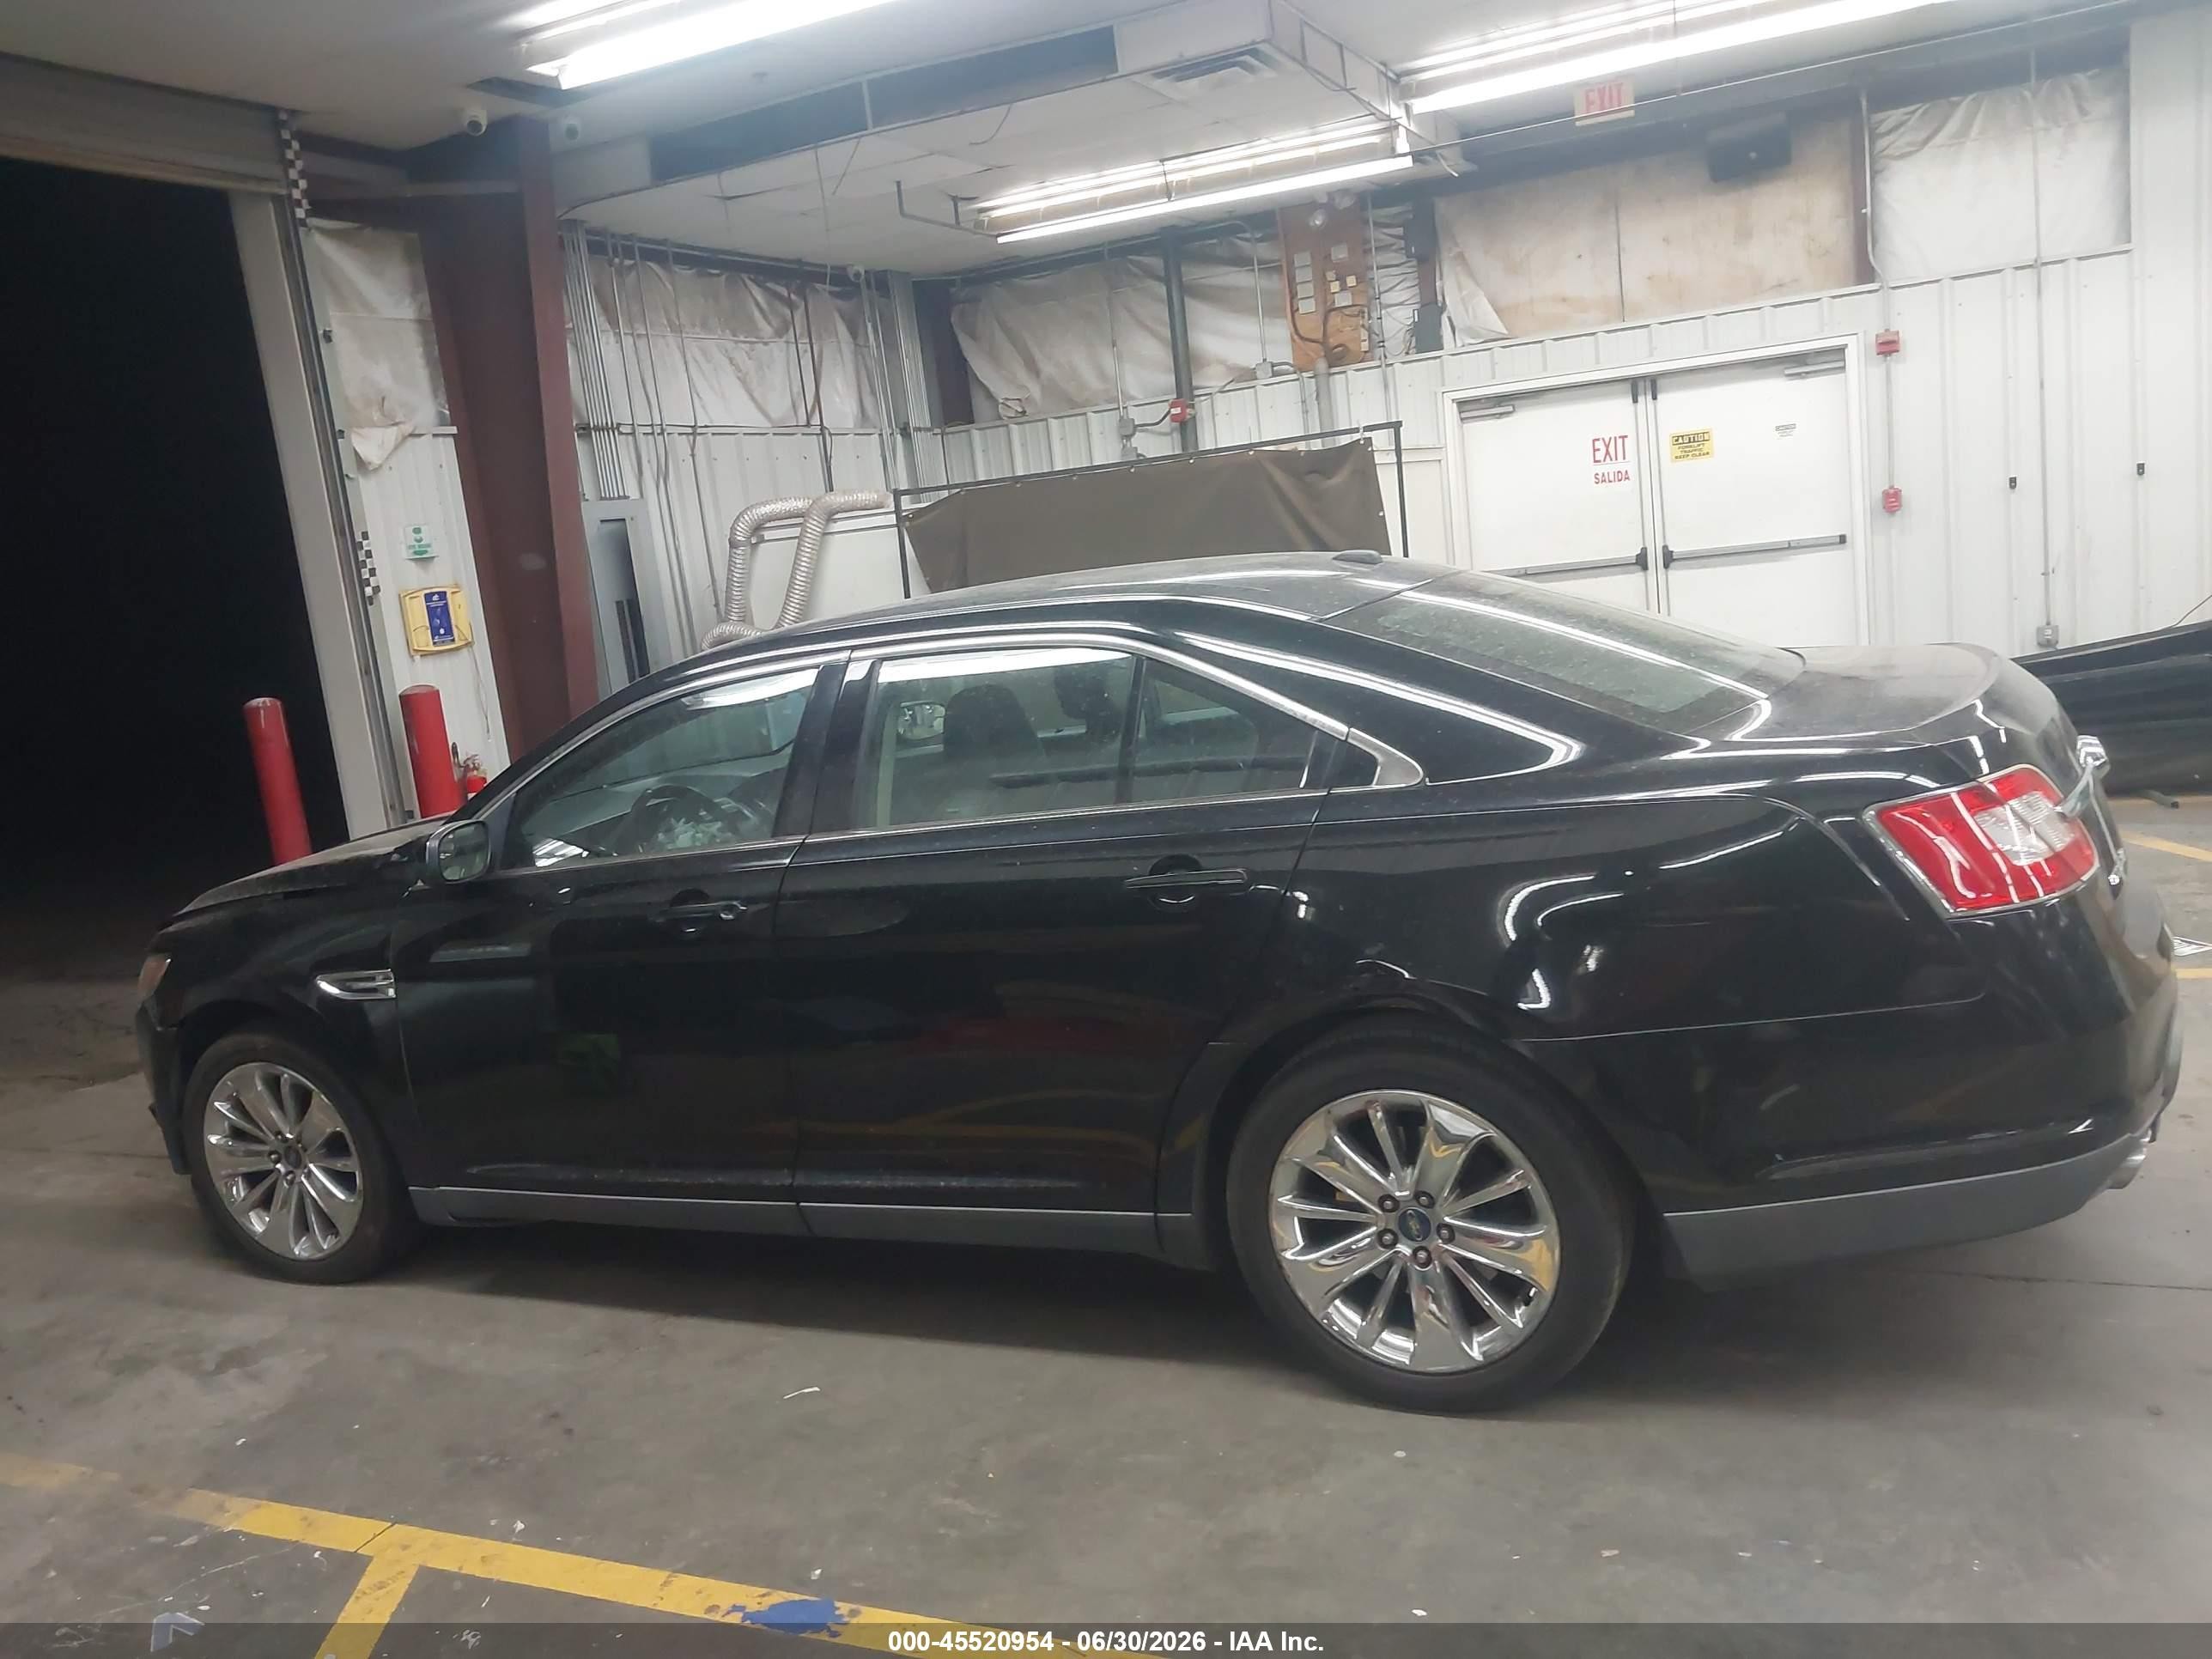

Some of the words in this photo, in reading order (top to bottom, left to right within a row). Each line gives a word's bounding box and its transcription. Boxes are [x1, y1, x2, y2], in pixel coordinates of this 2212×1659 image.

[1584, 82, 1623, 116] EXIT
[1592, 434, 1628, 463] EXIT
[1672, 432, 1710, 446] CAUTION
[1594, 470, 1630, 484] SALIDA
